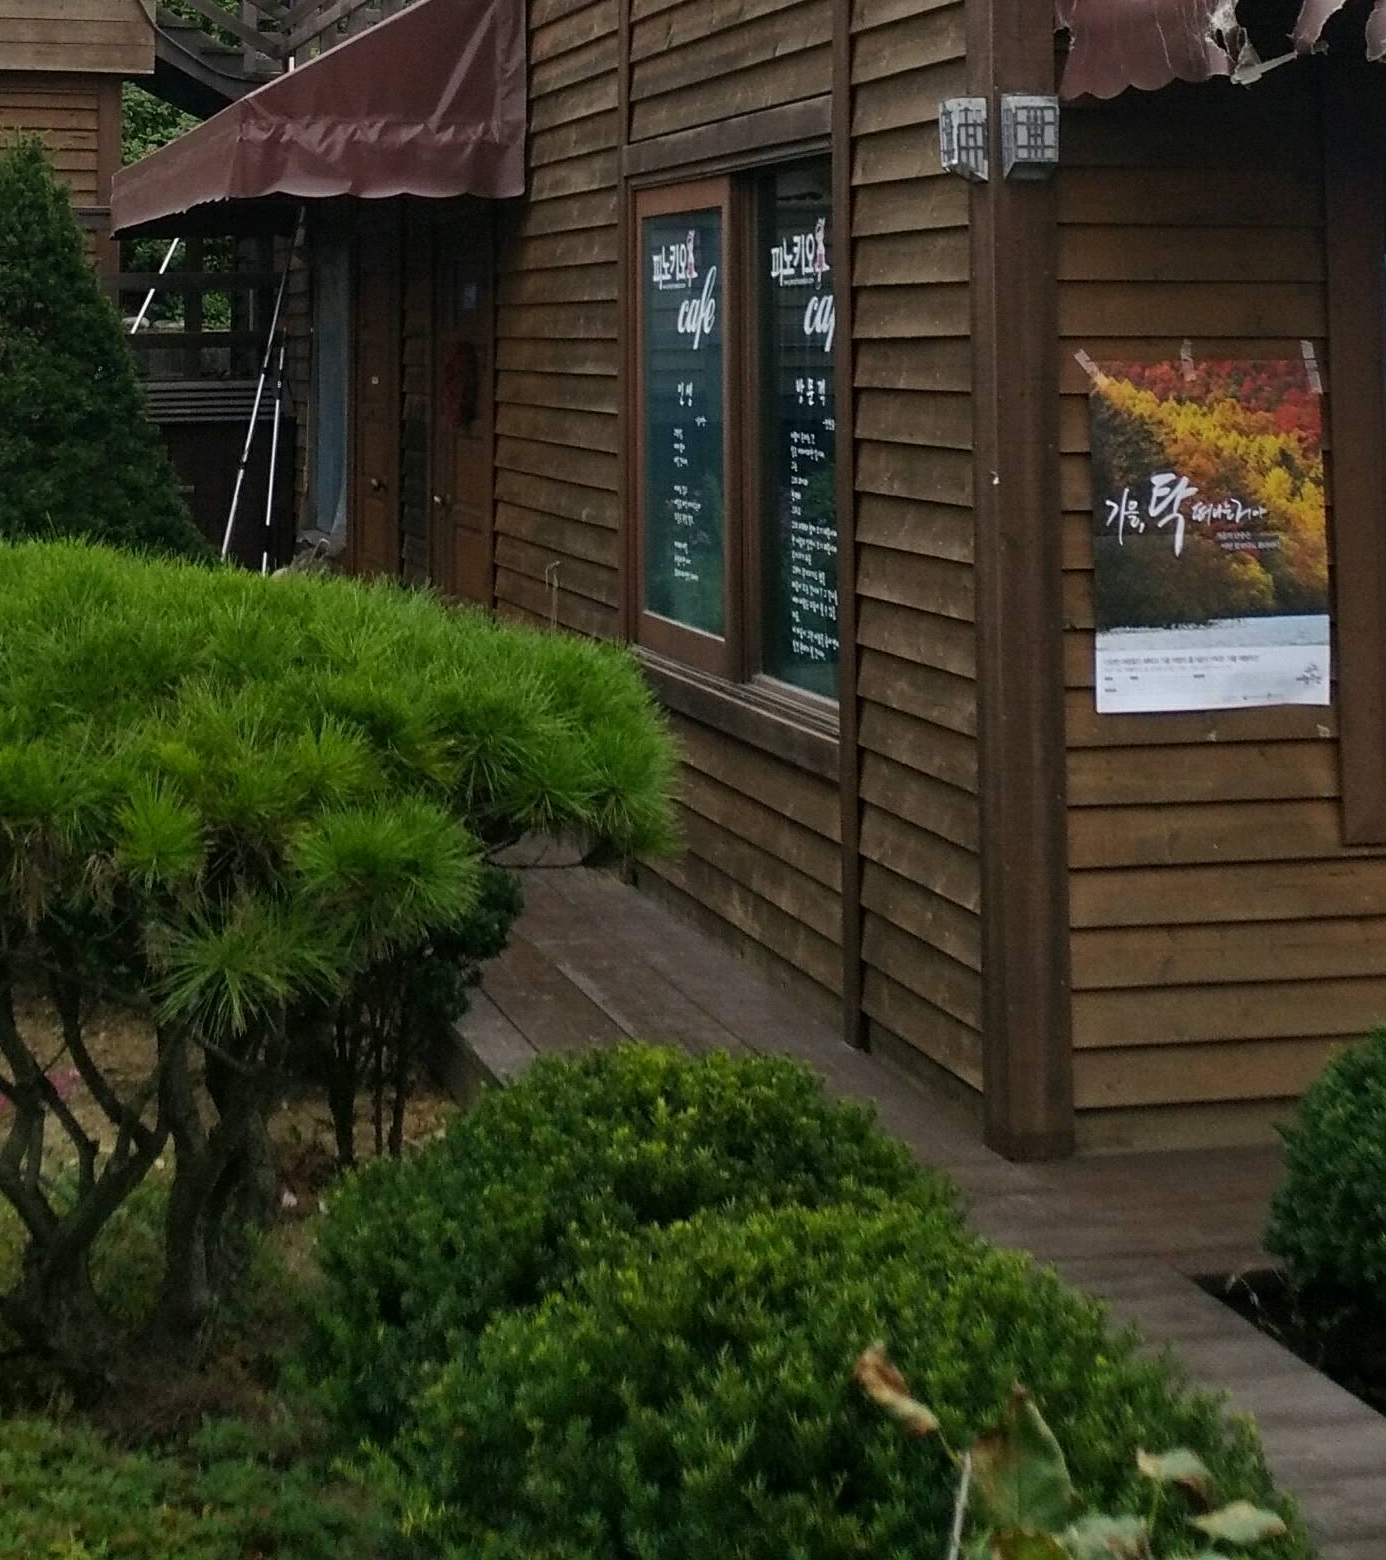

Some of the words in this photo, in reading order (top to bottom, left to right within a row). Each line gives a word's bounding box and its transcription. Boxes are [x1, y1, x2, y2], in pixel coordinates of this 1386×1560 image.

[653, 244, 687, 290] 피노키오
[771, 233, 816, 287] 피노키오
[677, 265, 717, 350] cafe
[1148, 472, 1199, 558] 탁
